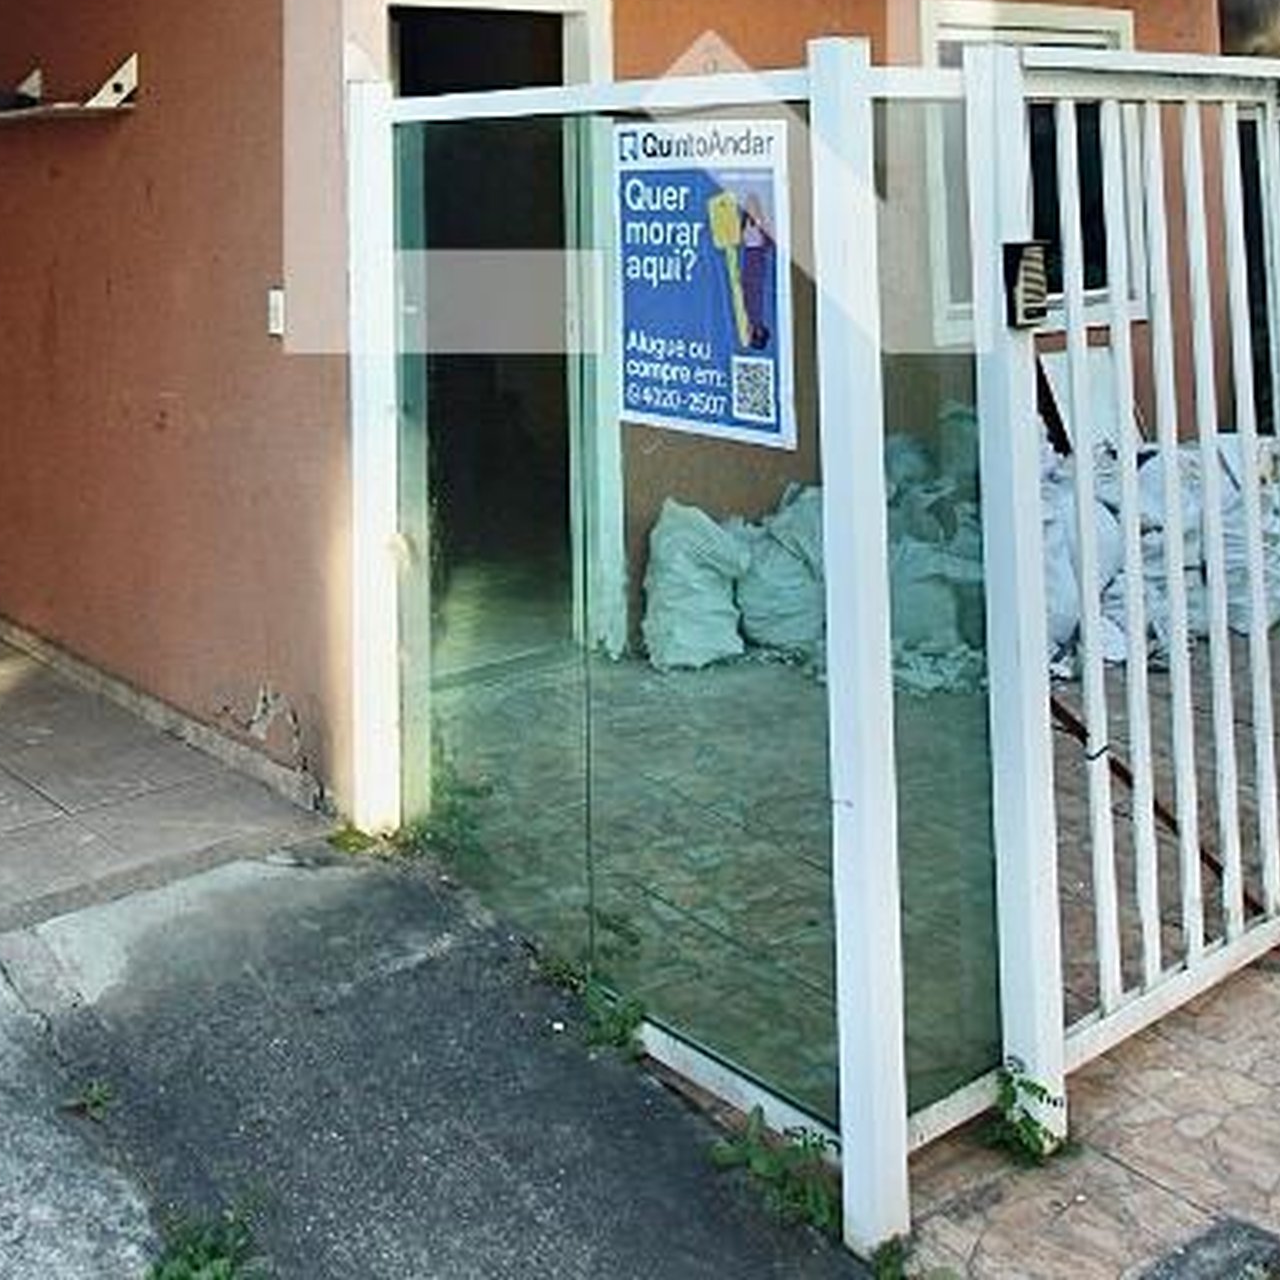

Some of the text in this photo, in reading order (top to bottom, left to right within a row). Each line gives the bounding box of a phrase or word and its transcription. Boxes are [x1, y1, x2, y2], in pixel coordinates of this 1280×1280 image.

[642, 129, 775, 158] QuntoAndar
[625, 179, 690, 211] Quer
[625, 221, 705, 247] morar
[625, 249, 697, 288] aqui?
[689, 342, 712, 361] ou
[626, 360, 691, 386] compre
